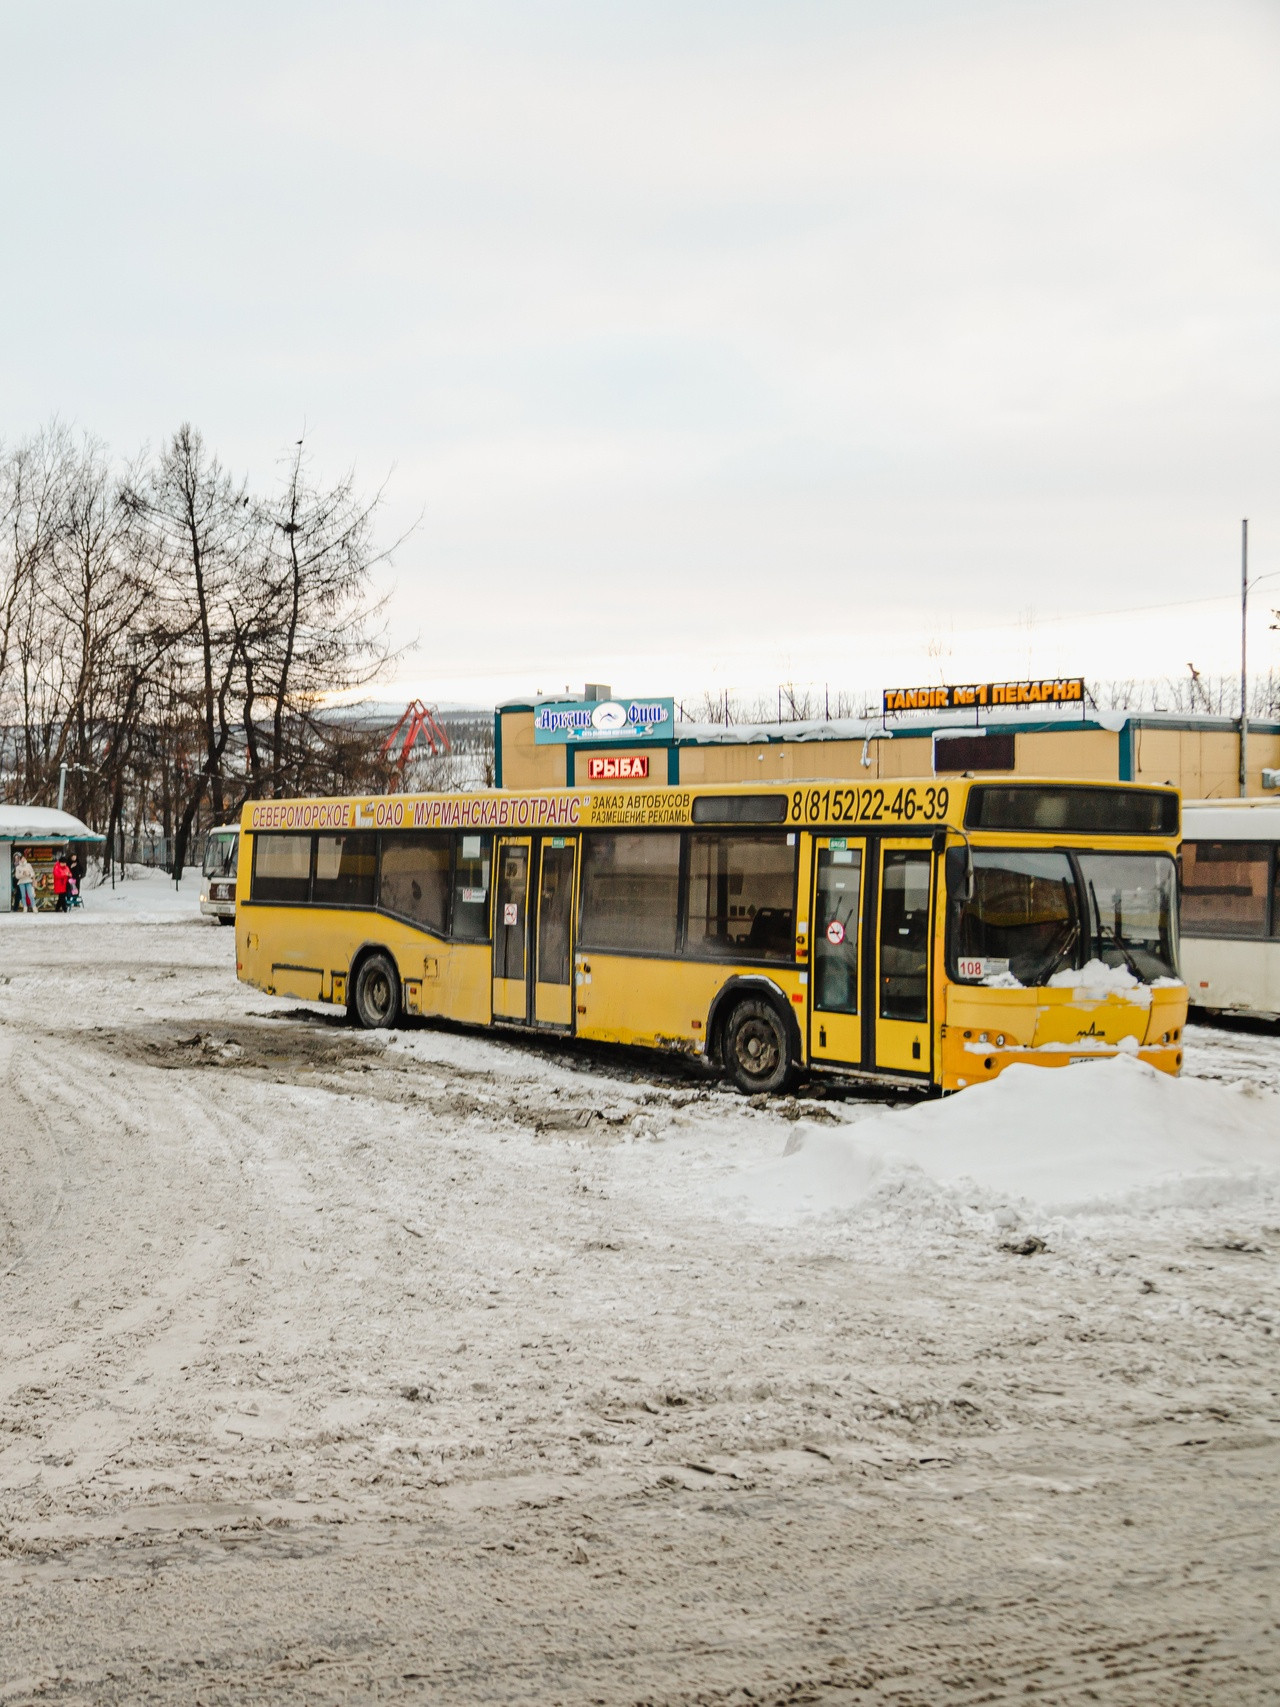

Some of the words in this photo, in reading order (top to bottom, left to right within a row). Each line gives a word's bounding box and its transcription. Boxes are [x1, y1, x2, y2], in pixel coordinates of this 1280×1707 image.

[884, 686, 949, 709] TANDIR
[953, 684, 988, 705] №1
[992, 680, 1081, 704] ПЕКАРНЯ
[592, 758, 644, 777] РЫБА
[592, 796, 625, 809] ЗАКАЗ
[626, 794, 690, 808] АВТОБУСОВ
[791, 787, 949, 823] 8(8152)22-46-39
[252, 804, 350, 827] СЕВЕРОМОРСКОЕ
[376, 803, 403, 826] ОАО
[590, 810, 647, 824] РАЗМЕЩЕНИЕ
[648, 809, 690, 823] РЕКЛАМЫ
[960, 962, 981, 976] 108
